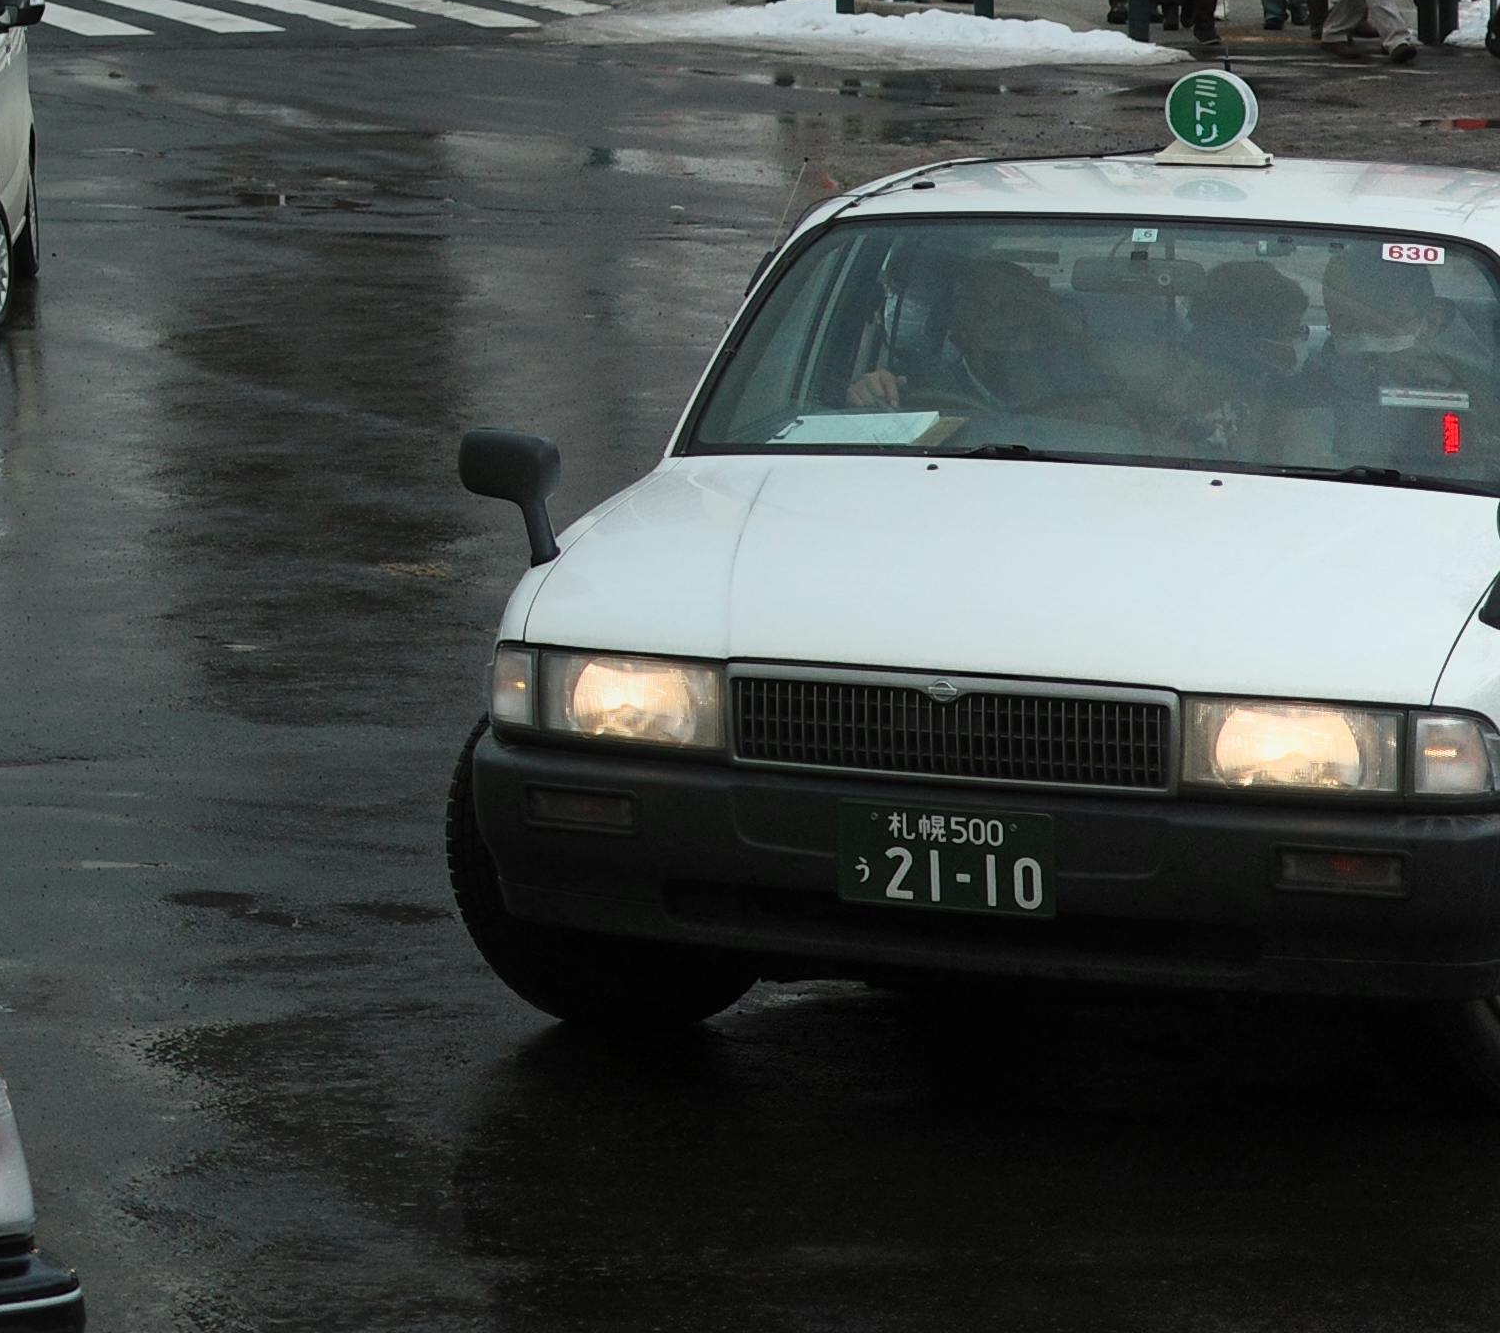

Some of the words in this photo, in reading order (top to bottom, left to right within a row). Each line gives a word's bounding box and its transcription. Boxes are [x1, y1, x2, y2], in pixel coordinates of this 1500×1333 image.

[1387, 244, 1440, 264] 630
[887, 811, 1005, 848] 札幌500
[855, 854, 871, 883] う
[885, 843, 1043, 911] 21-10
